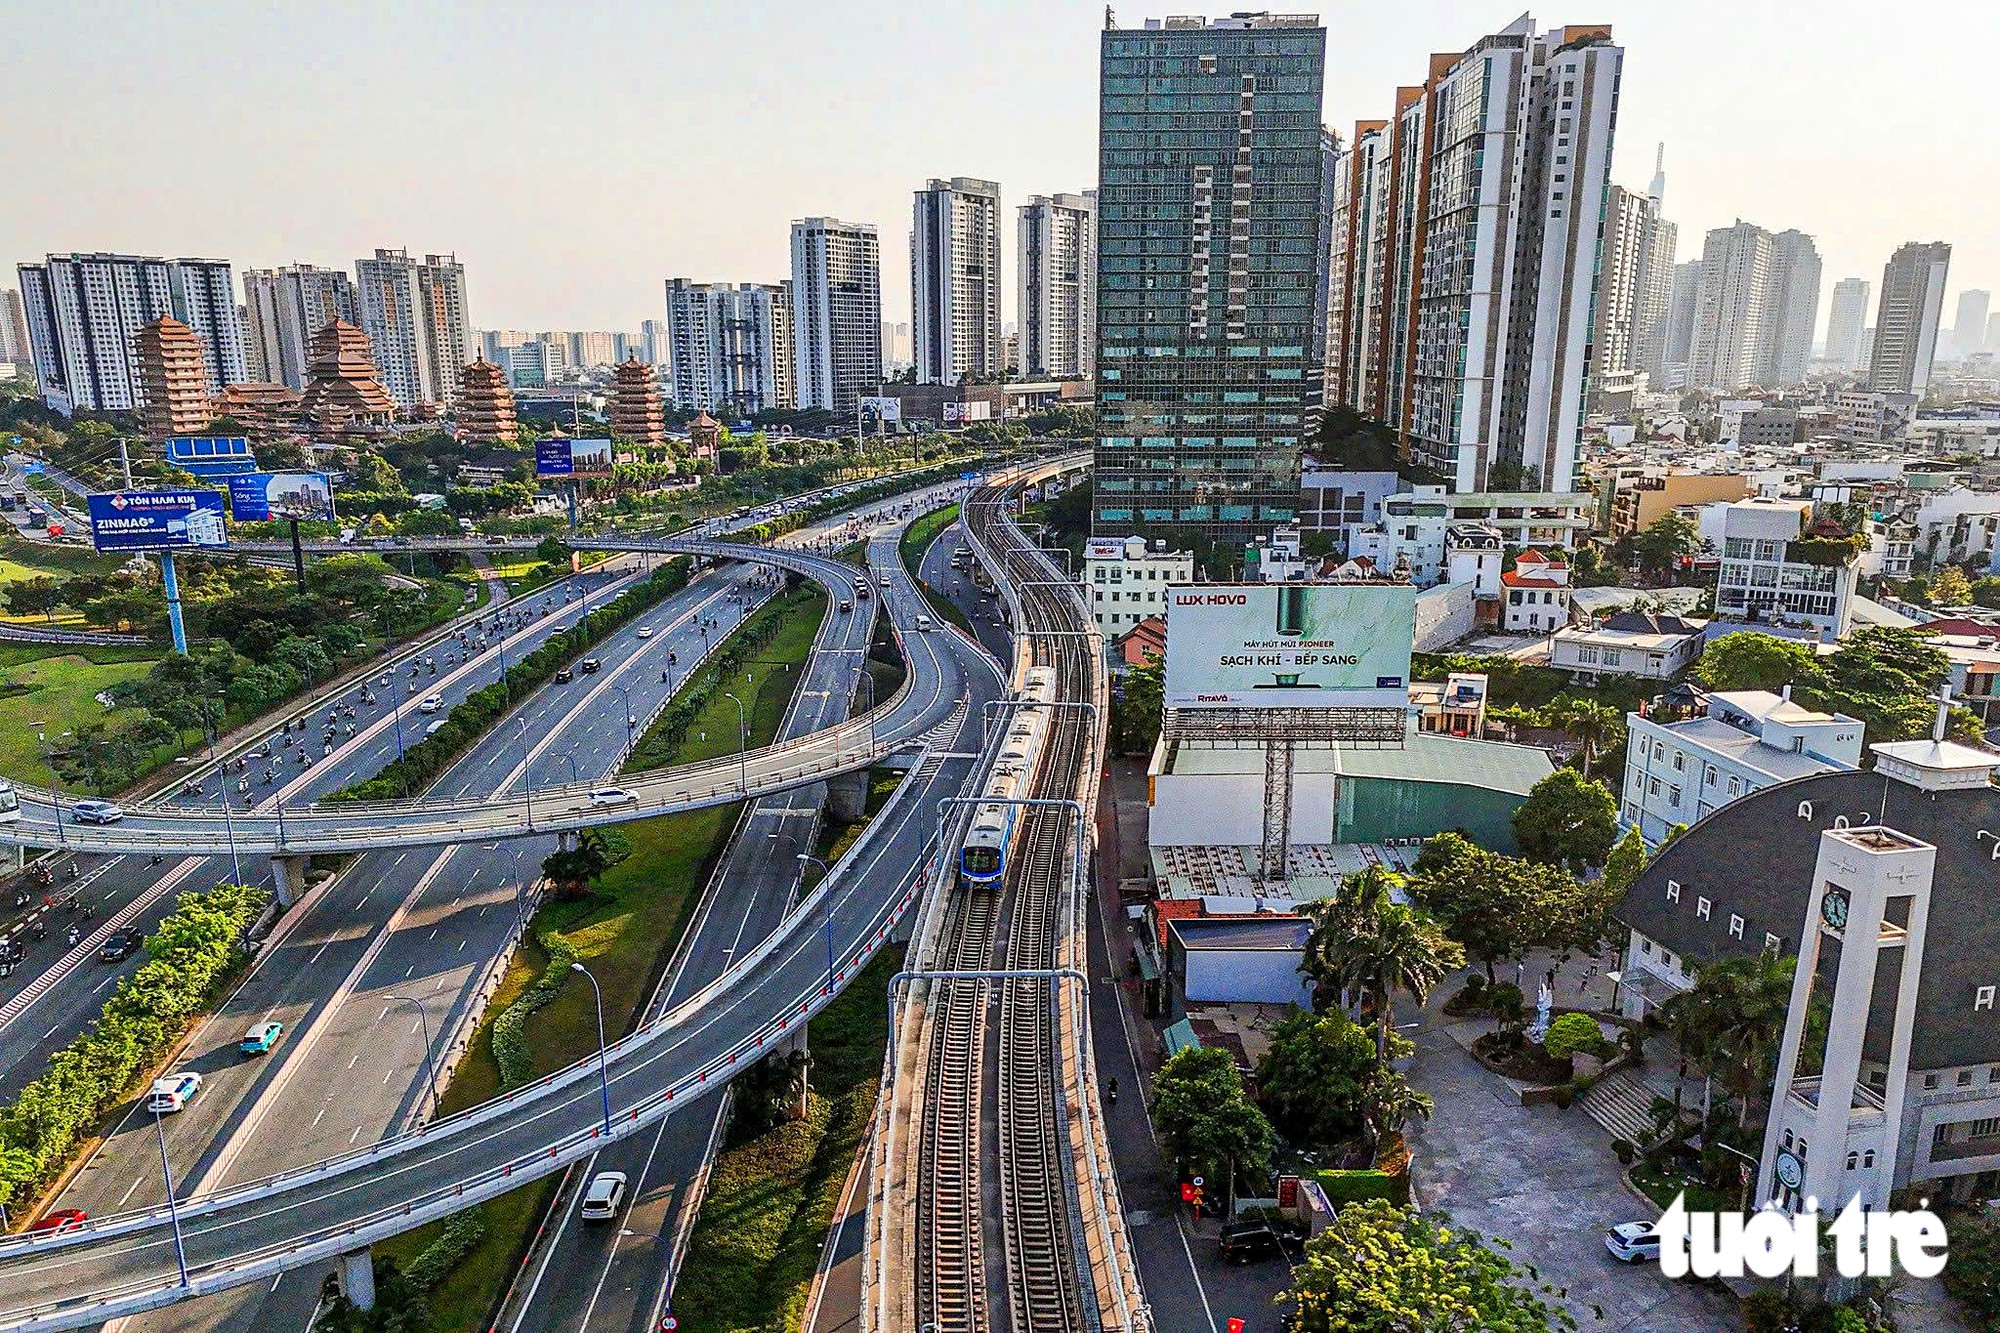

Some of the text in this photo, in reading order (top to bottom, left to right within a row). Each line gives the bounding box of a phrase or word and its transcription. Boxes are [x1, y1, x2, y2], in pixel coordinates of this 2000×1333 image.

[128, 495, 196, 506] TÔN NAM KIM
[1176, 594, 1247, 606] LUX HOVO
[1243, 639, 1335, 648] MÁY HÚT MÙI PIONEER
[1220, 655, 1253, 668] SẠCH
[1257, 652, 1282, 666] KHÍ
[1294, 651, 1319, 665] BẾP
[1321, 654, 1358, 665] SANG
